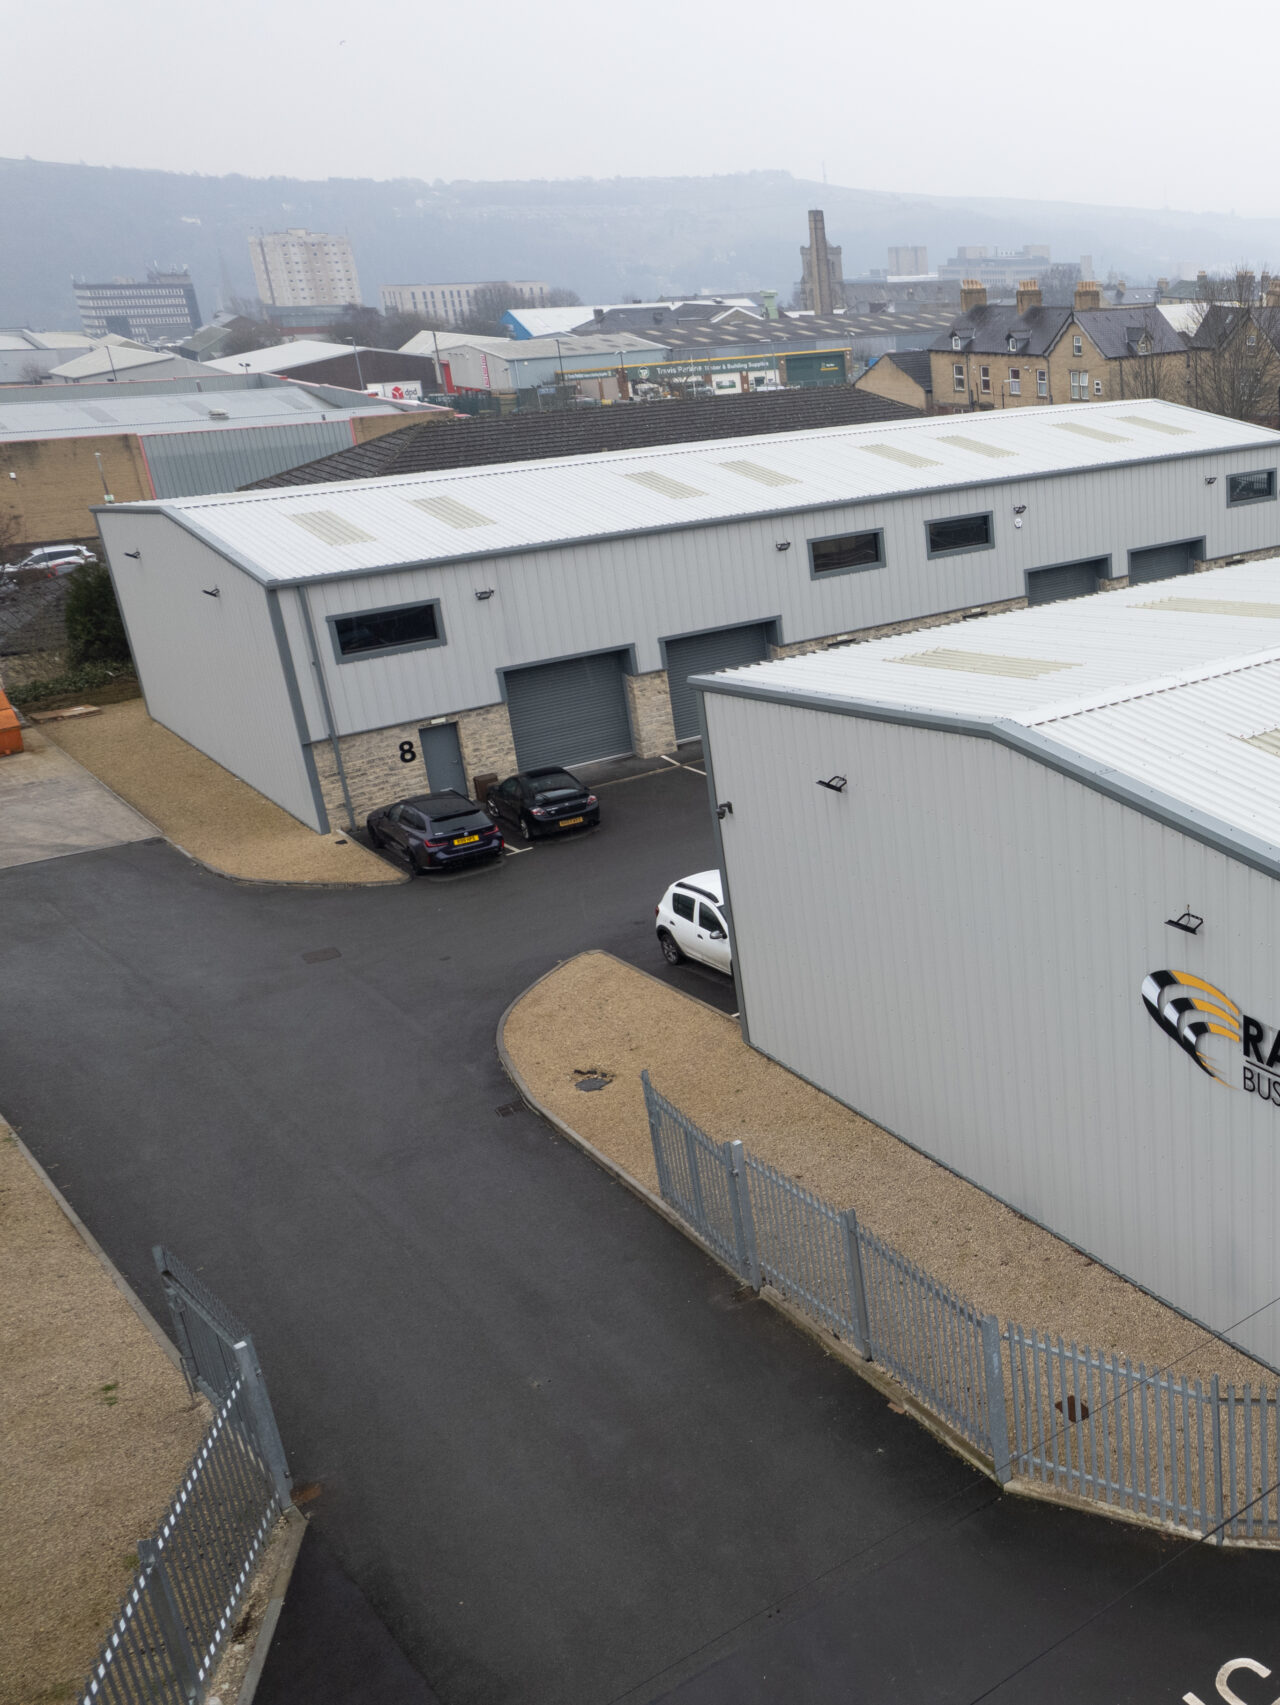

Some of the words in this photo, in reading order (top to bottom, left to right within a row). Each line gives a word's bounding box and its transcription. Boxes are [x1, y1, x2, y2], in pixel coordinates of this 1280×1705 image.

[656, 366, 677, 375] Travis
[405, 388, 417, 399] dpd
[399, 740, 417, 763] 8
